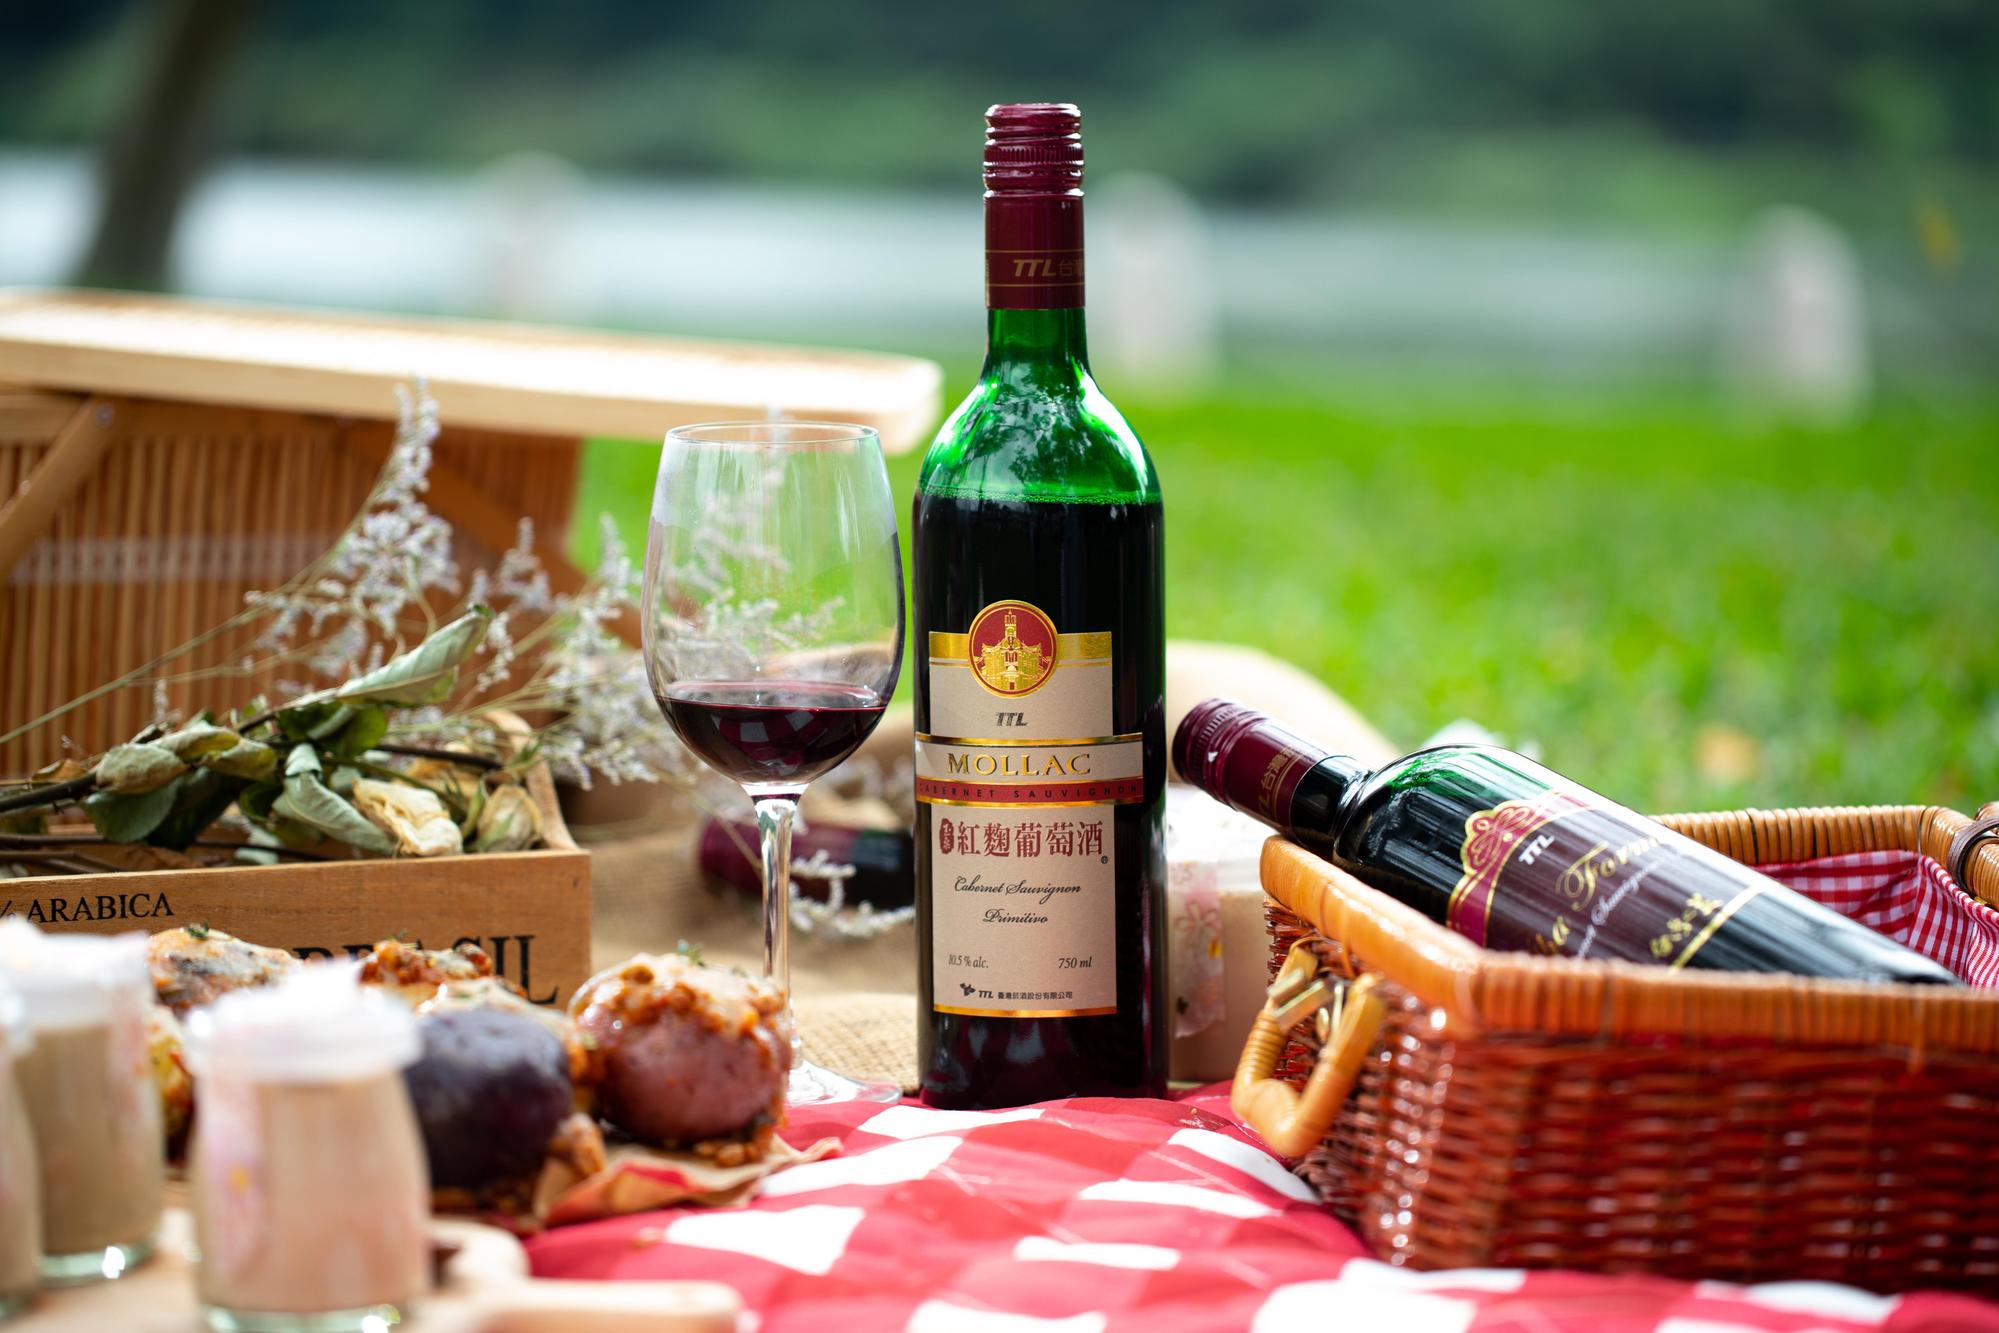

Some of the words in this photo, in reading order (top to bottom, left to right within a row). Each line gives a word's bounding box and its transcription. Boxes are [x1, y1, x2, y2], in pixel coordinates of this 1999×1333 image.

[1013, 259, 1057, 277] TTL
[995, 712, 1028, 727] TTL
[947, 752, 1091, 776] MOLLAC
[918, 782, 995, 798] CABERNET
[1013, 784, 1137, 799] SAUVIGNON
[1518, 835, 1555, 865] TTL
[954, 874, 1005, 893] Cabernet
[1005, 880, 1081, 905] Sauvignon
[27, 891, 175, 923] ARABICA
[982, 908, 1048, 924] Primitivo
[1058, 957, 1078, 969] 750
[1079, 956, 1093, 968] ml
[978, 990, 994, 999] TTL
